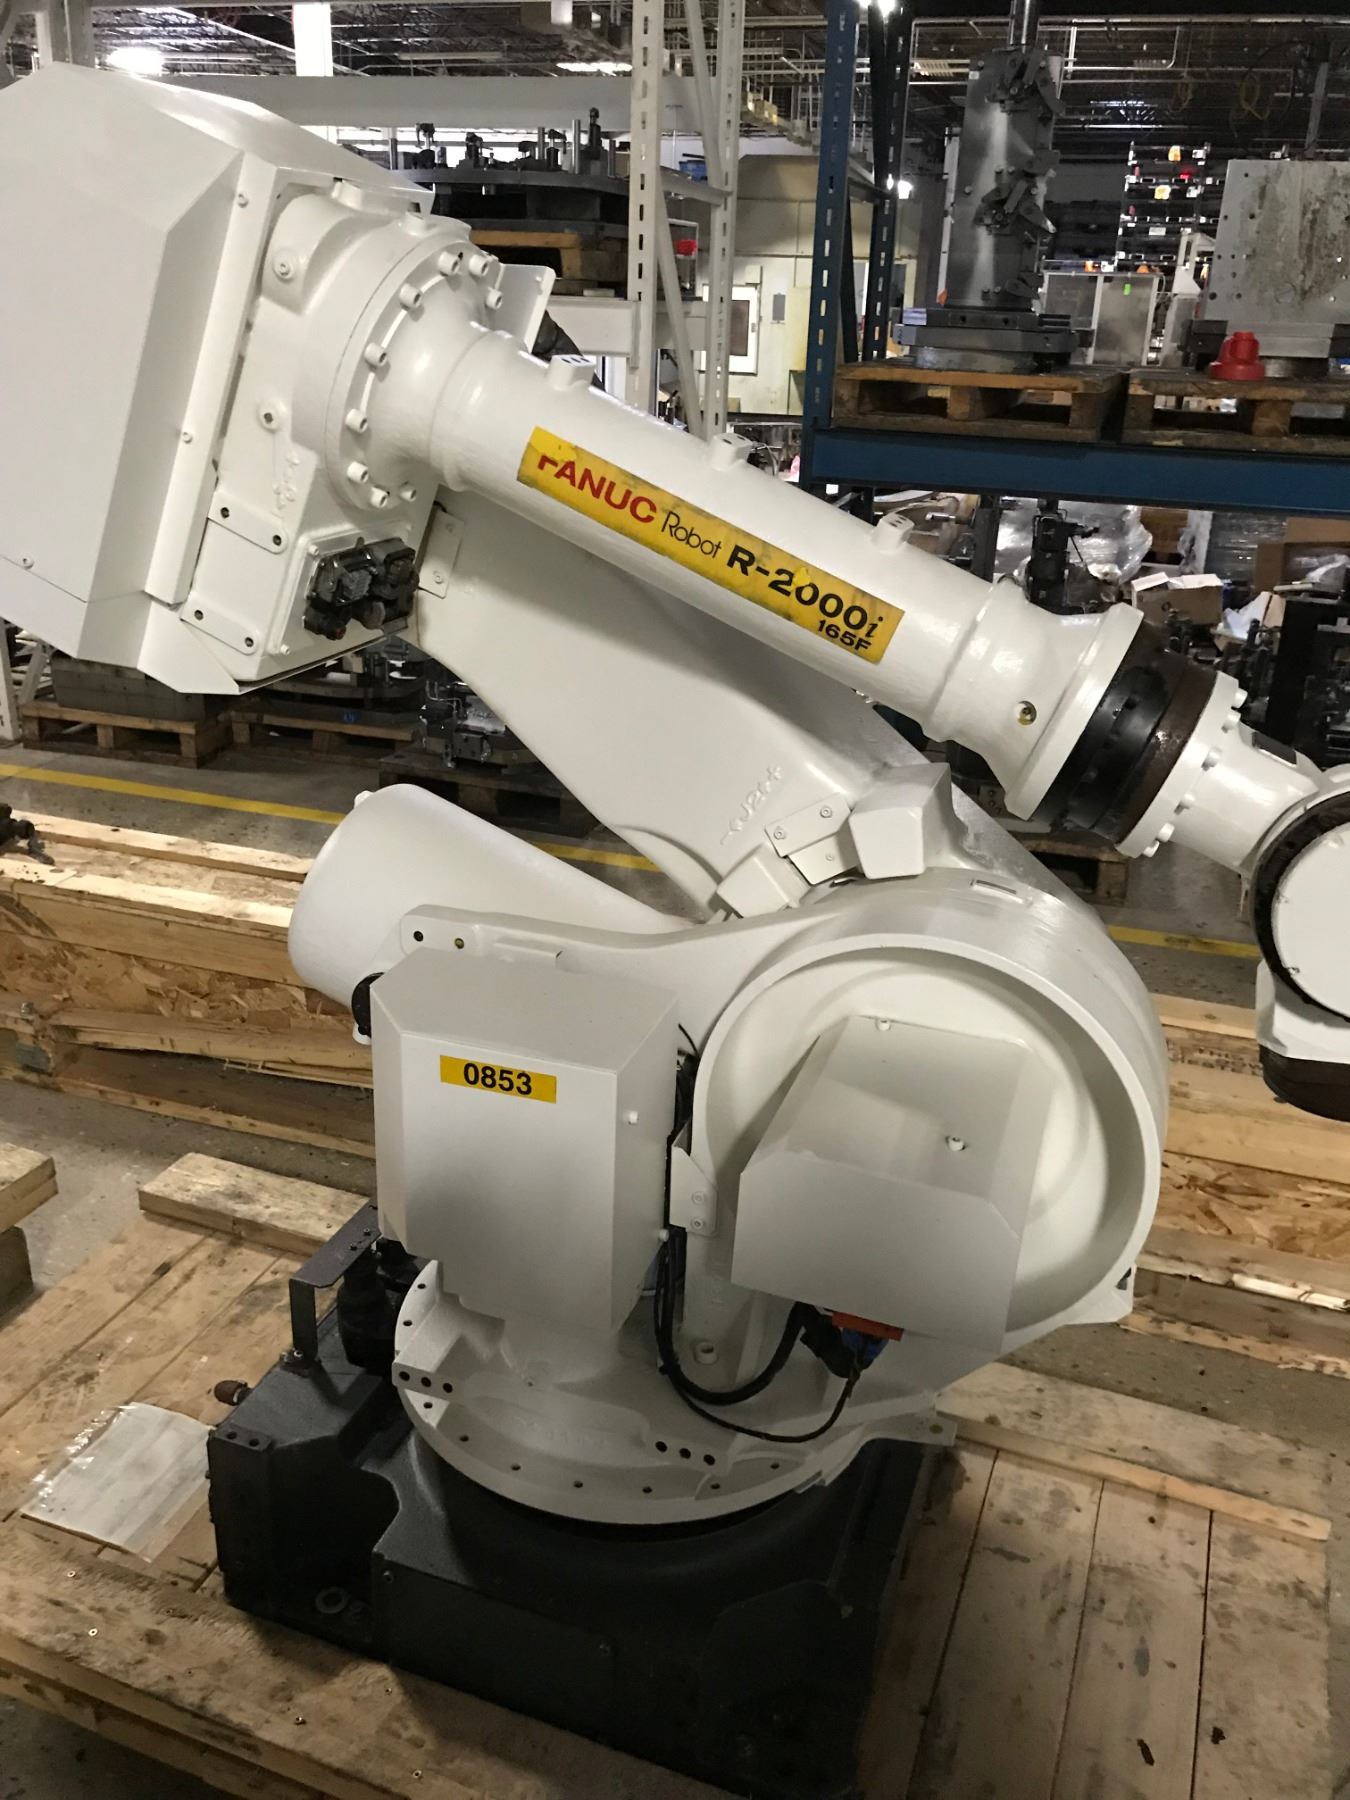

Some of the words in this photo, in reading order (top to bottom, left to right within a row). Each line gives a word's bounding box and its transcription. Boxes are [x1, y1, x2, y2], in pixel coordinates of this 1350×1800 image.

[662, 511, 722, 559] Robot
[728, 545, 883, 638] R-2000i
[818, 620, 872, 653] 165F
[463, 1063, 533, 1096] 0853
